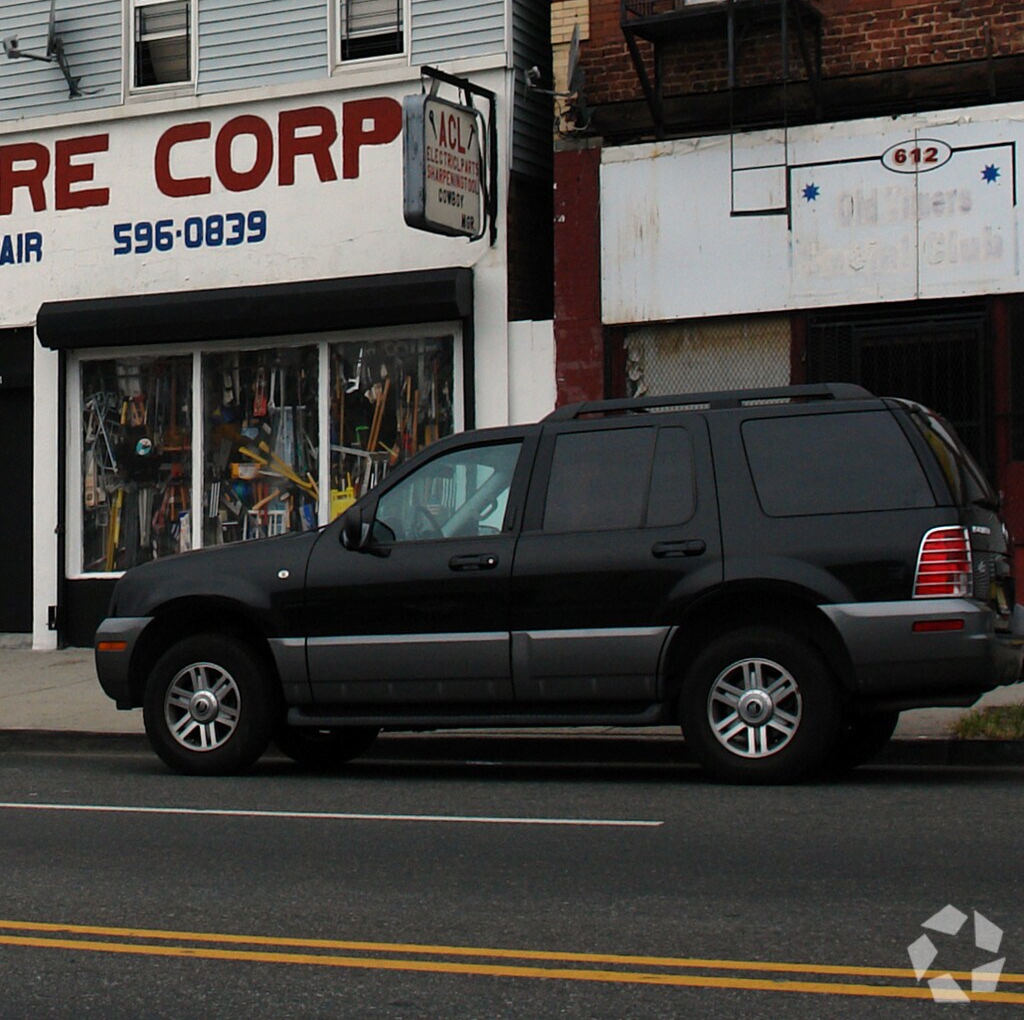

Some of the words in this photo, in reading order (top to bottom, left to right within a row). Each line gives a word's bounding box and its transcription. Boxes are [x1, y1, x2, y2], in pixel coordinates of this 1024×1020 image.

[154, 96, 403, 198] CORP
[439, 111, 466, 154] ACL
[894, 146, 938, 165] 612
[438, 188, 464, 208] COWBOY
